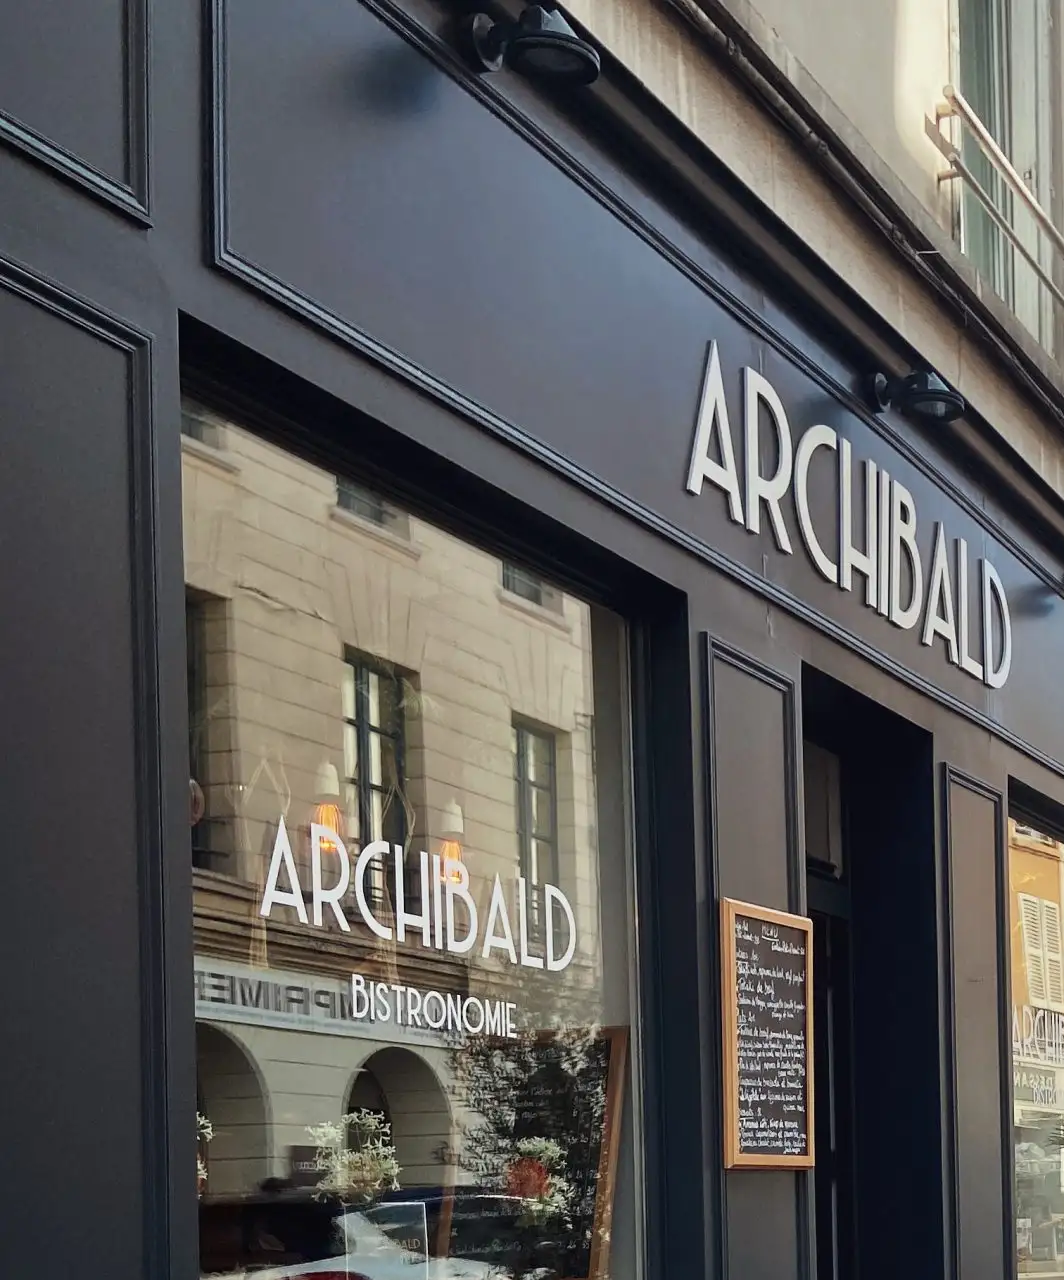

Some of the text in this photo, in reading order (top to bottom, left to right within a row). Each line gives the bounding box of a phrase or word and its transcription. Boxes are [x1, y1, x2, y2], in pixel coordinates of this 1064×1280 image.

[686, 338, 1012, 689] ARCHIBALD
[259, 814, 577, 972] ARCHIBALD
[351, 973, 518, 1039] BISTRONOMIE
